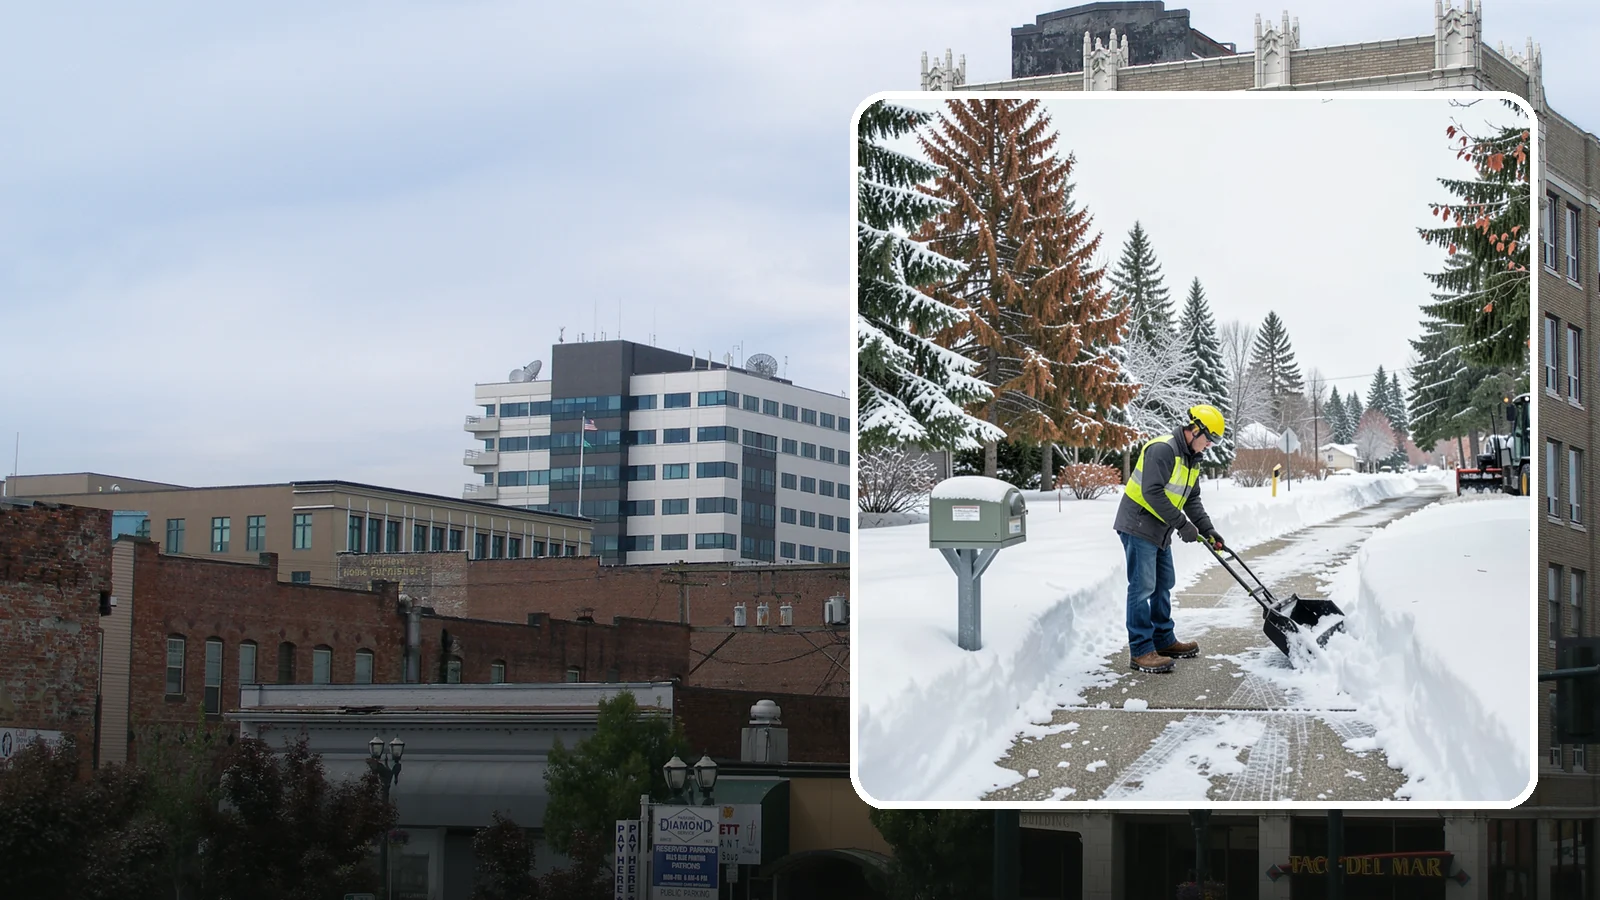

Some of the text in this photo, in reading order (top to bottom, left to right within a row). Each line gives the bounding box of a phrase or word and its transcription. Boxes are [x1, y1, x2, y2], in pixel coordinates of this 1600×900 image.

[370, 566, 427, 576] Furnishers
[660, 818, 713, 832] DIAMOND
[1022, 815, 1069, 827] BUILDING
[617, 825, 625, 893] PAY HERE
[627, 825, 636, 893] PAY HERE
[1289, 855, 1442, 877] TAC DEL MAR
[660, 889, 710, 898] PUBLIC PARKING
